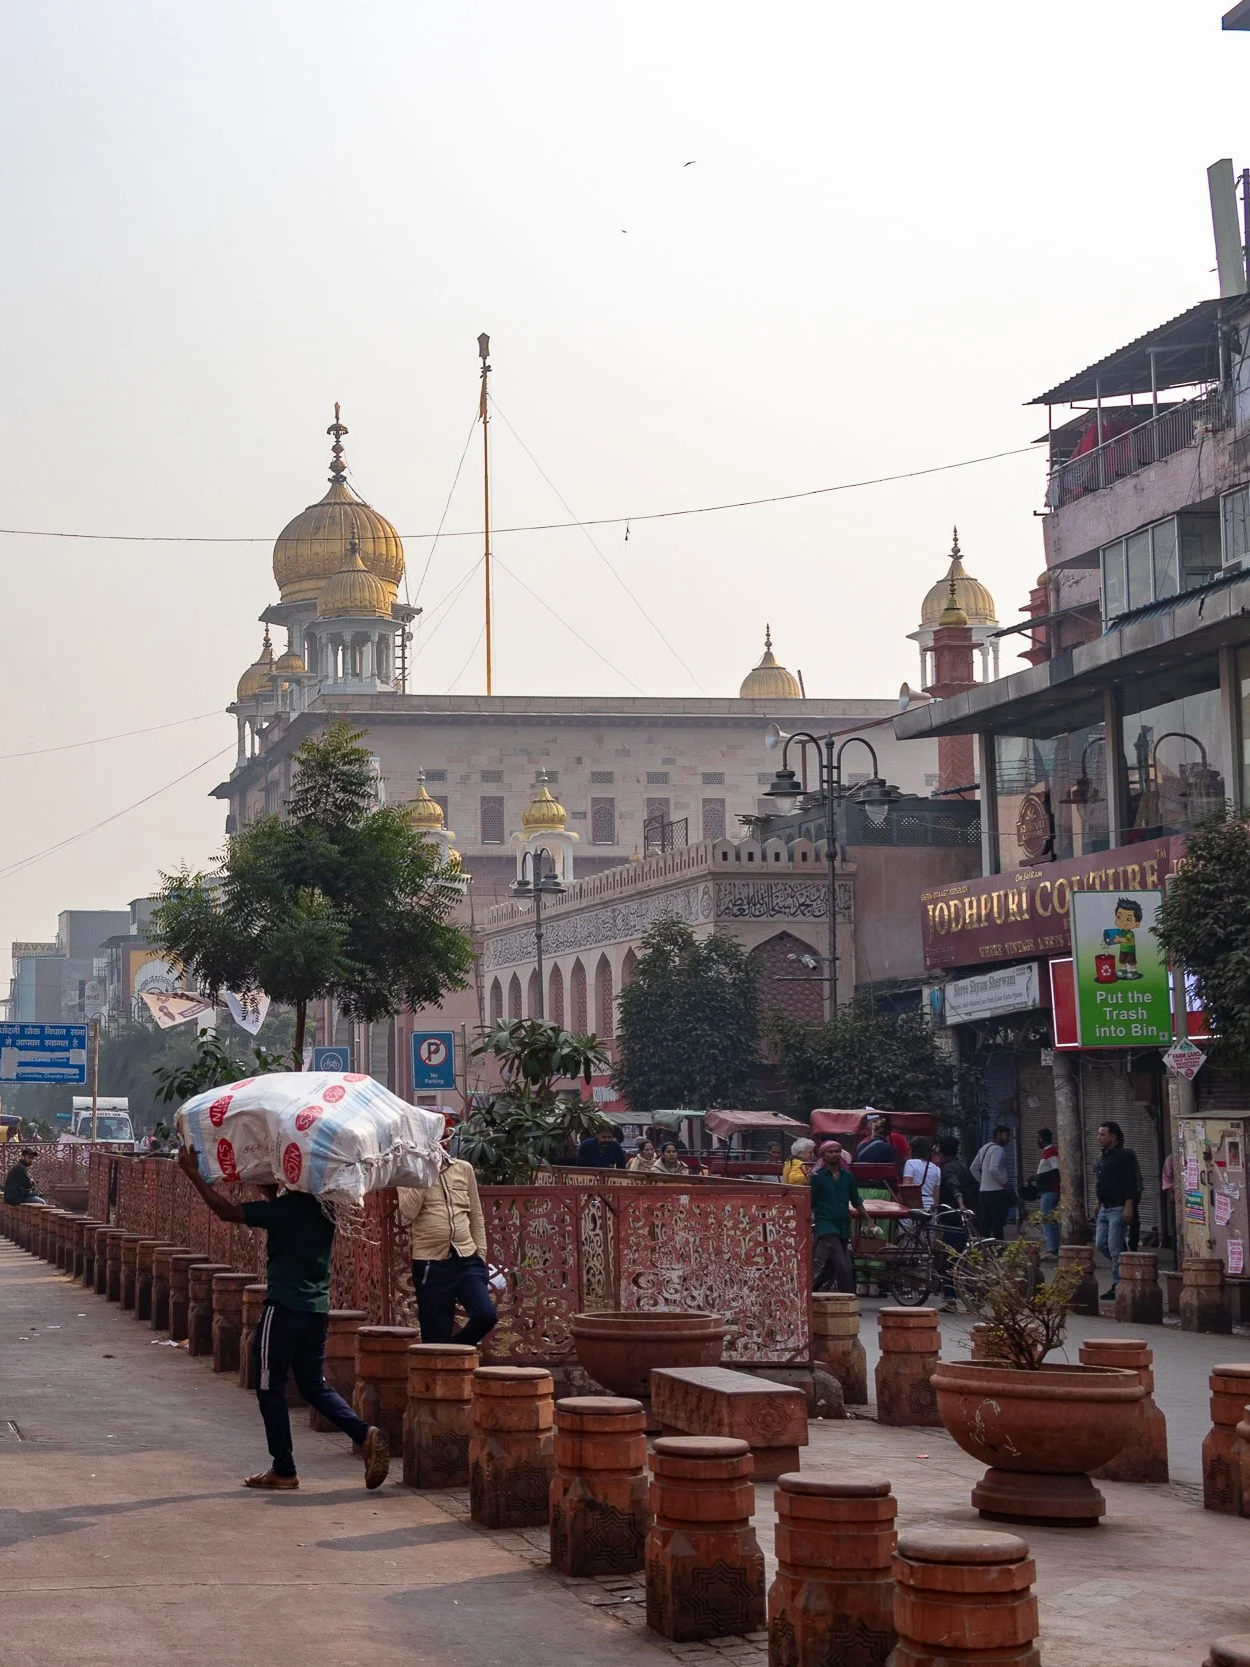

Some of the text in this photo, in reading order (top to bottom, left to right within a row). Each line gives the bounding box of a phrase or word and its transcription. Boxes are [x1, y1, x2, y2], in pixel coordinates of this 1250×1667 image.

[927, 885, 1030, 944] JODHPURI
[1096, 991, 1152, 1004] Put the
[1103, 1007, 1147, 1020] Trash
[1096, 1023, 1157, 1037] into Bin
[219, 1144, 232, 1176] NICS
[287, 1147, 301, 1182] NICS
